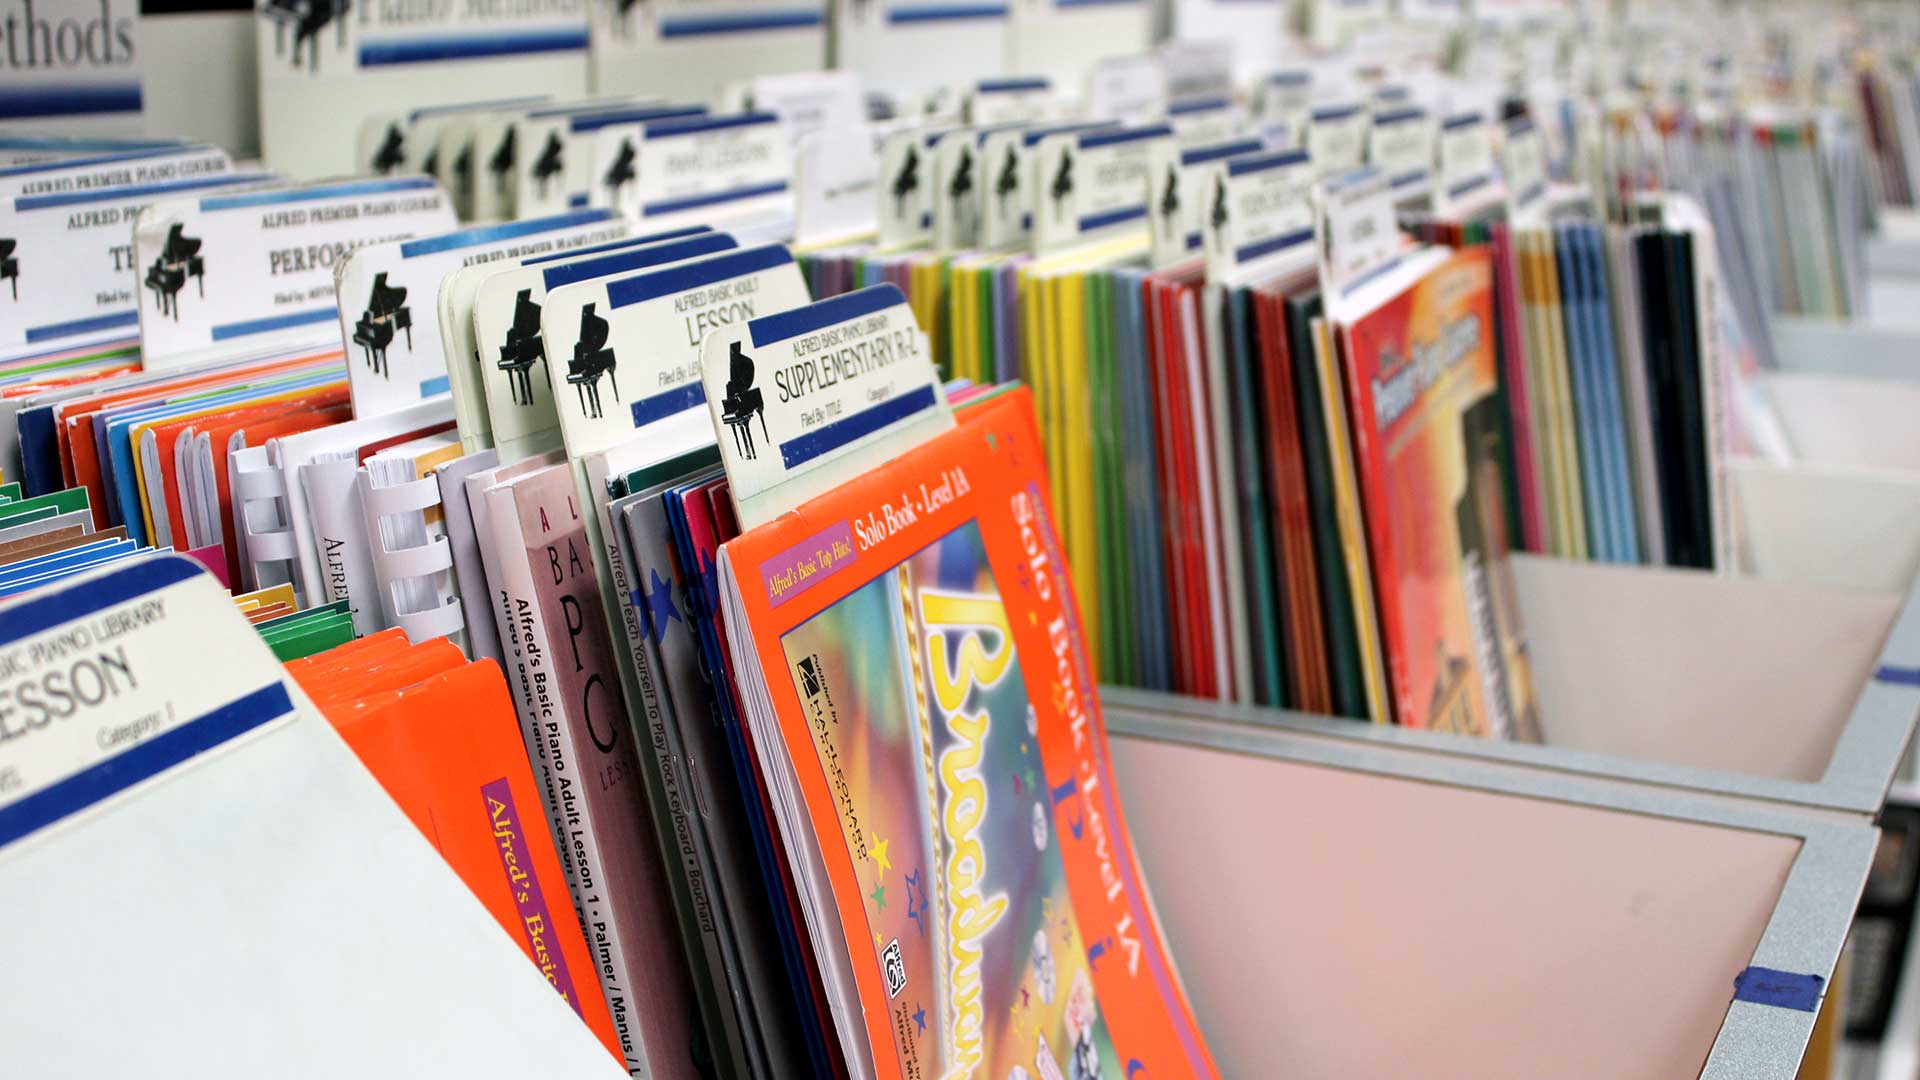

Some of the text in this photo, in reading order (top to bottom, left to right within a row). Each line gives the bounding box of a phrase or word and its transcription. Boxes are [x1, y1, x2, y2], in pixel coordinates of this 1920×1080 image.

[0, 0, 136, 68] thods
[67, 209, 120, 230] ALFRED
[262, 209, 307, 229] ALFRED
[674, 276, 761, 313] ALFRED BASIC ADULT
[774, 333, 895, 404] SUPPLEMENTARY
[793, 336, 821, 358] ALFRED
[821, 328, 842, 348] BASIC
[855, 512, 886, 551] Solo
[882, 493, 918, 535] Book
[919, 471, 955, 514] Level
[769, 536, 852, 598] Alfred's Basic Top Hits!
[29, 624, 91, 666] PIANO
[91, 596, 166, 643] LIBRARY
[516, 598, 542, 668] Alfred's
[533, 672, 553, 719] Basic
[812, 653, 839, 725] Published by
[1010, 491, 1052, 602] Solo
[1048, 614, 1087, 752] Book
[1083, 771, 1124, 902] Level
[545, 721, 565, 772] Piano
[608, 544, 715, 934] Alfred's Teach Yourself To Play Rock Keyboard Bouchard
[558, 776, 580, 827] Adult
[571, 830, 594, 890] Lesson
[487, 796, 558, 986] Alfred's Basic
[587, 894, 600, 904] 1
[593, 921, 617, 983] Palmer
[892, 943, 906, 985] Alfred
[612, 996, 634, 1054] Manus
[895, 1009, 909, 1055] Alfred
[902, 1001, 918, 1064] Distributed
